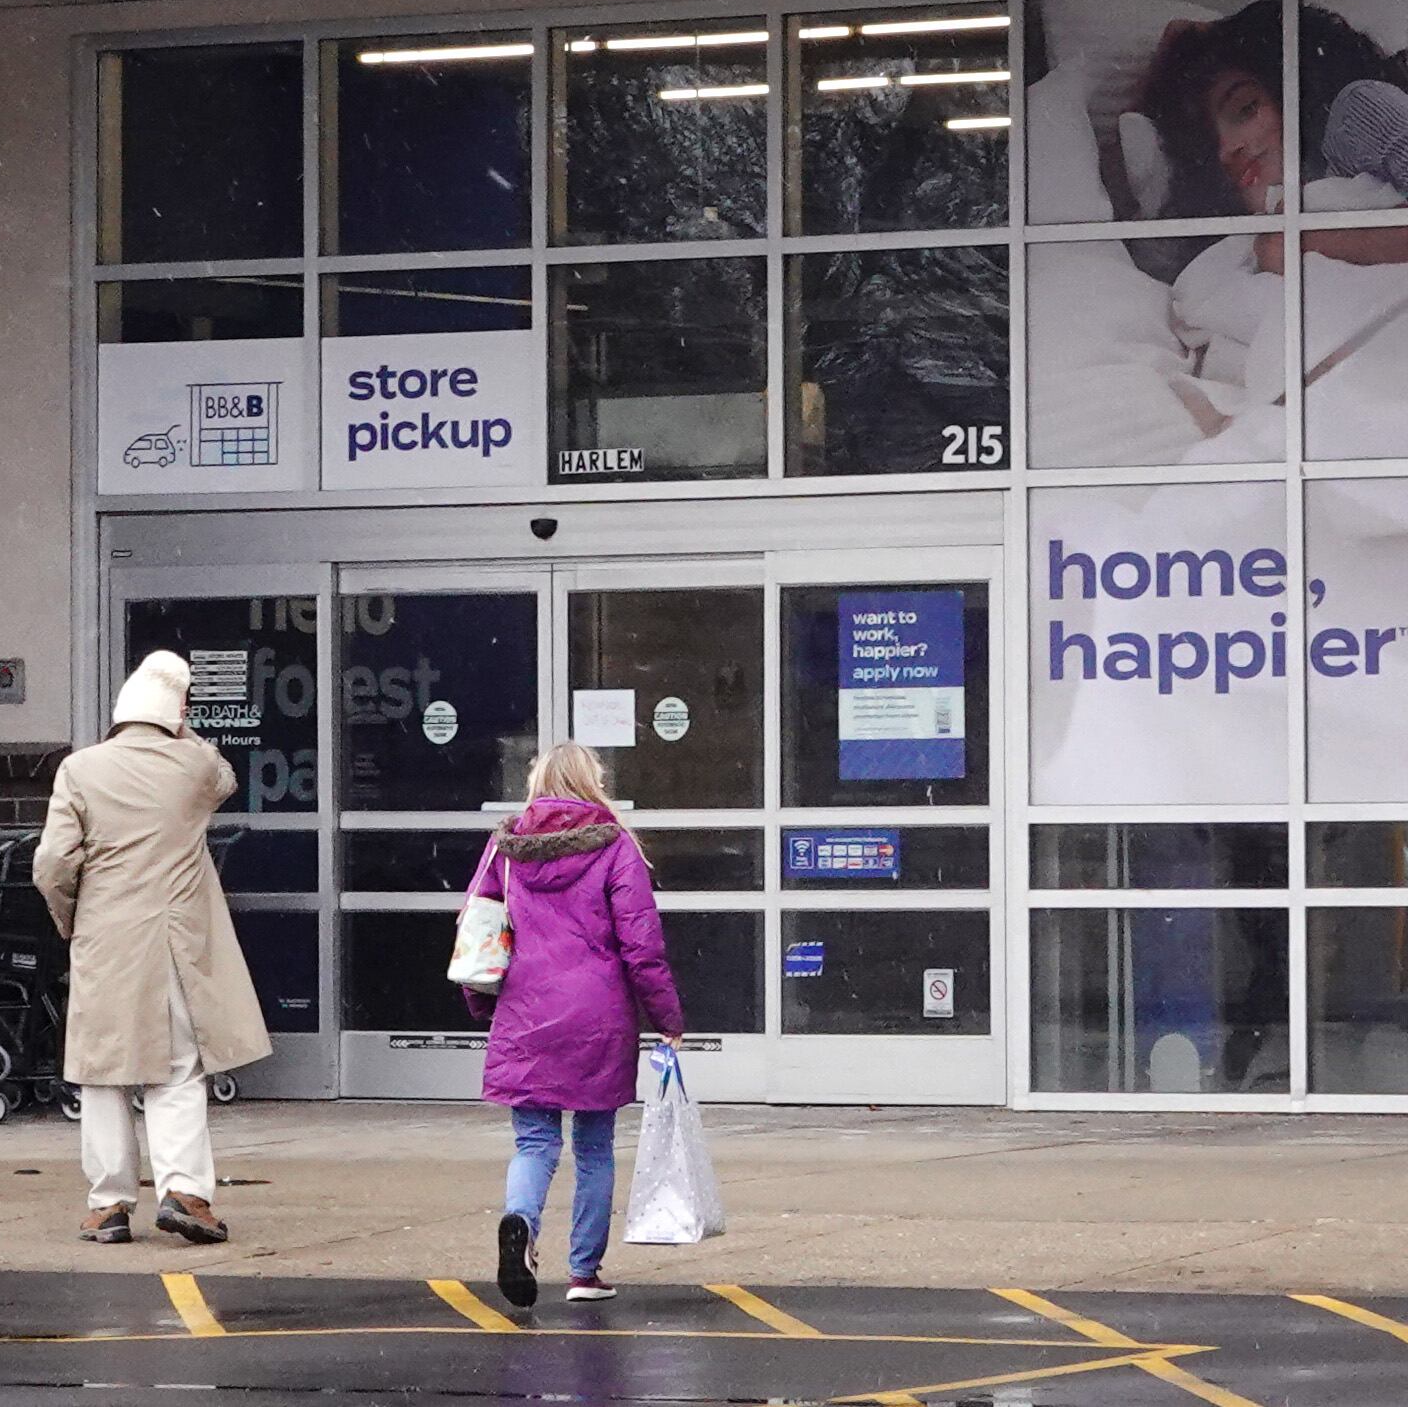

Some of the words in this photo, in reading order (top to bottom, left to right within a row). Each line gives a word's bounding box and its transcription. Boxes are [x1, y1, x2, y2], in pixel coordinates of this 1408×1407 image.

[348, 365, 479, 400] store
[205, 395, 264, 419] BB&B
[349, 411, 512, 462] pickup
[943, 425, 1003, 465] 215
[561, 449, 642, 472] HARLEM
[1049, 540, 1326, 608] home,
[852, 610, 897, 626] want
[899, 610, 918, 625] to
[852, 627, 899, 643] work,
[852, 643, 928, 661] happier?
[252, 647, 441, 719] foest
[852, 665, 901, 682] apply
[903, 666, 939, 679] now
[212, 704, 249, 719] BATH
[249, 704, 263, 718] &
[221, 734, 262, 746] Hours
